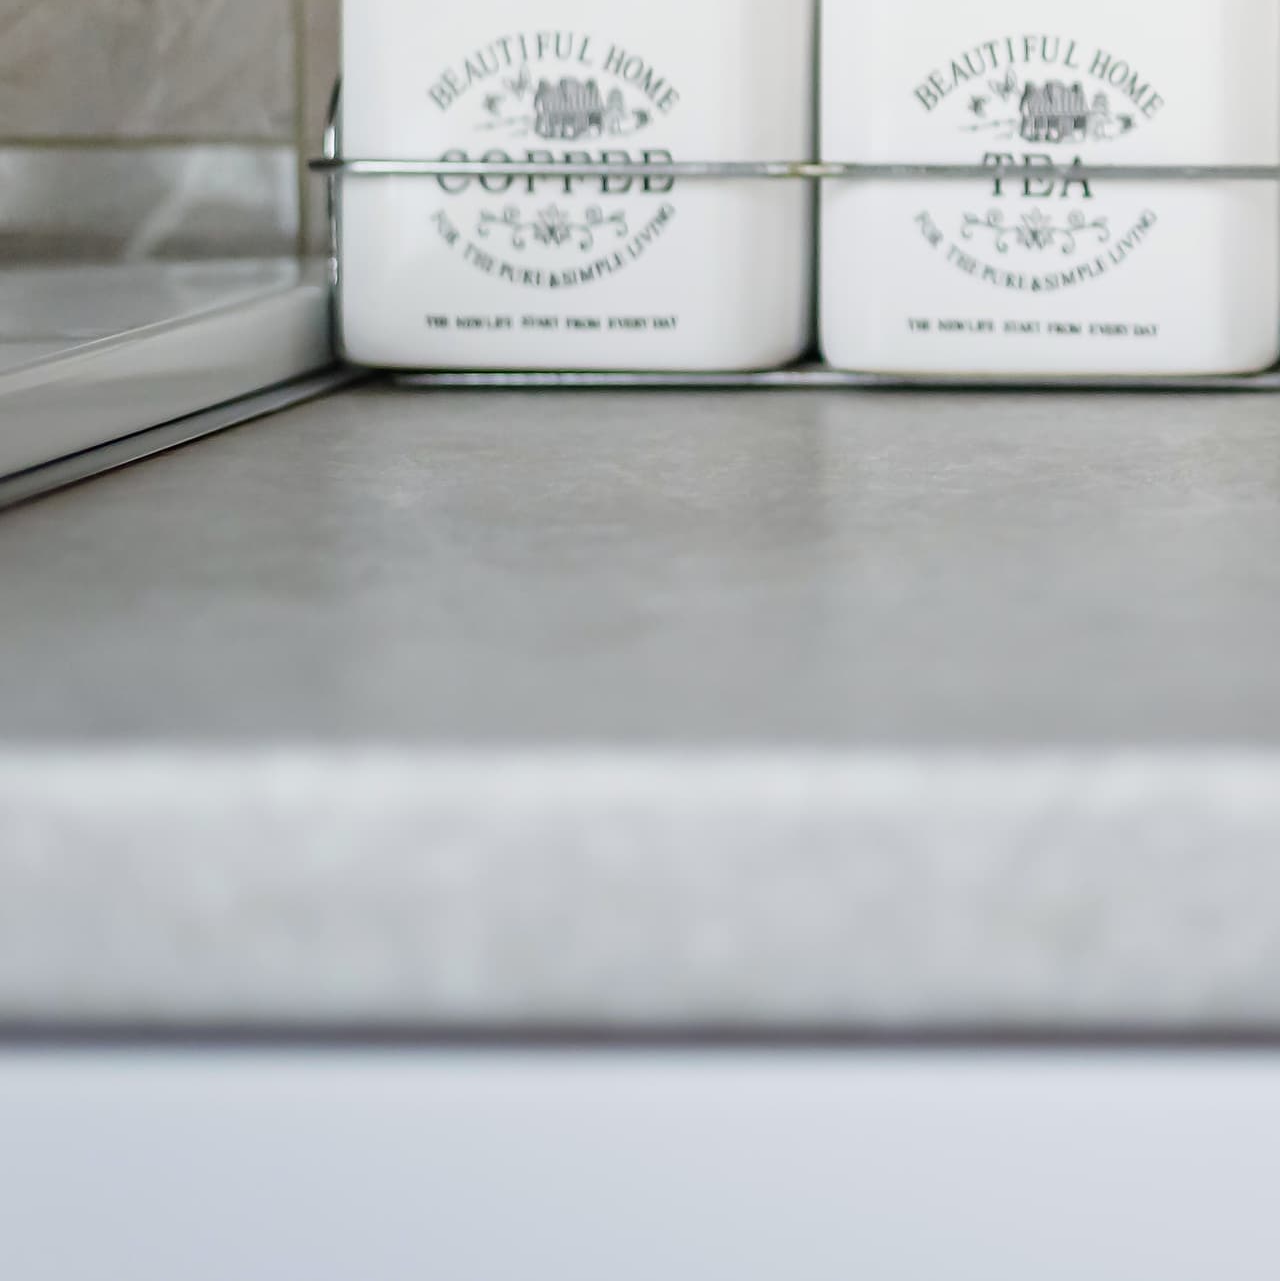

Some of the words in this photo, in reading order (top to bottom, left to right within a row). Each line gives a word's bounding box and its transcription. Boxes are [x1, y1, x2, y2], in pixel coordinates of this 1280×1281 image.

[428, 31, 591, 111] BEAUTIFUL
[604, 43, 680, 114] HOME
[913, 35, 1079, 113] BEAUTIFUL
[1088, 48, 1165, 119] HOME
[982, 151, 1093, 198] TEA
